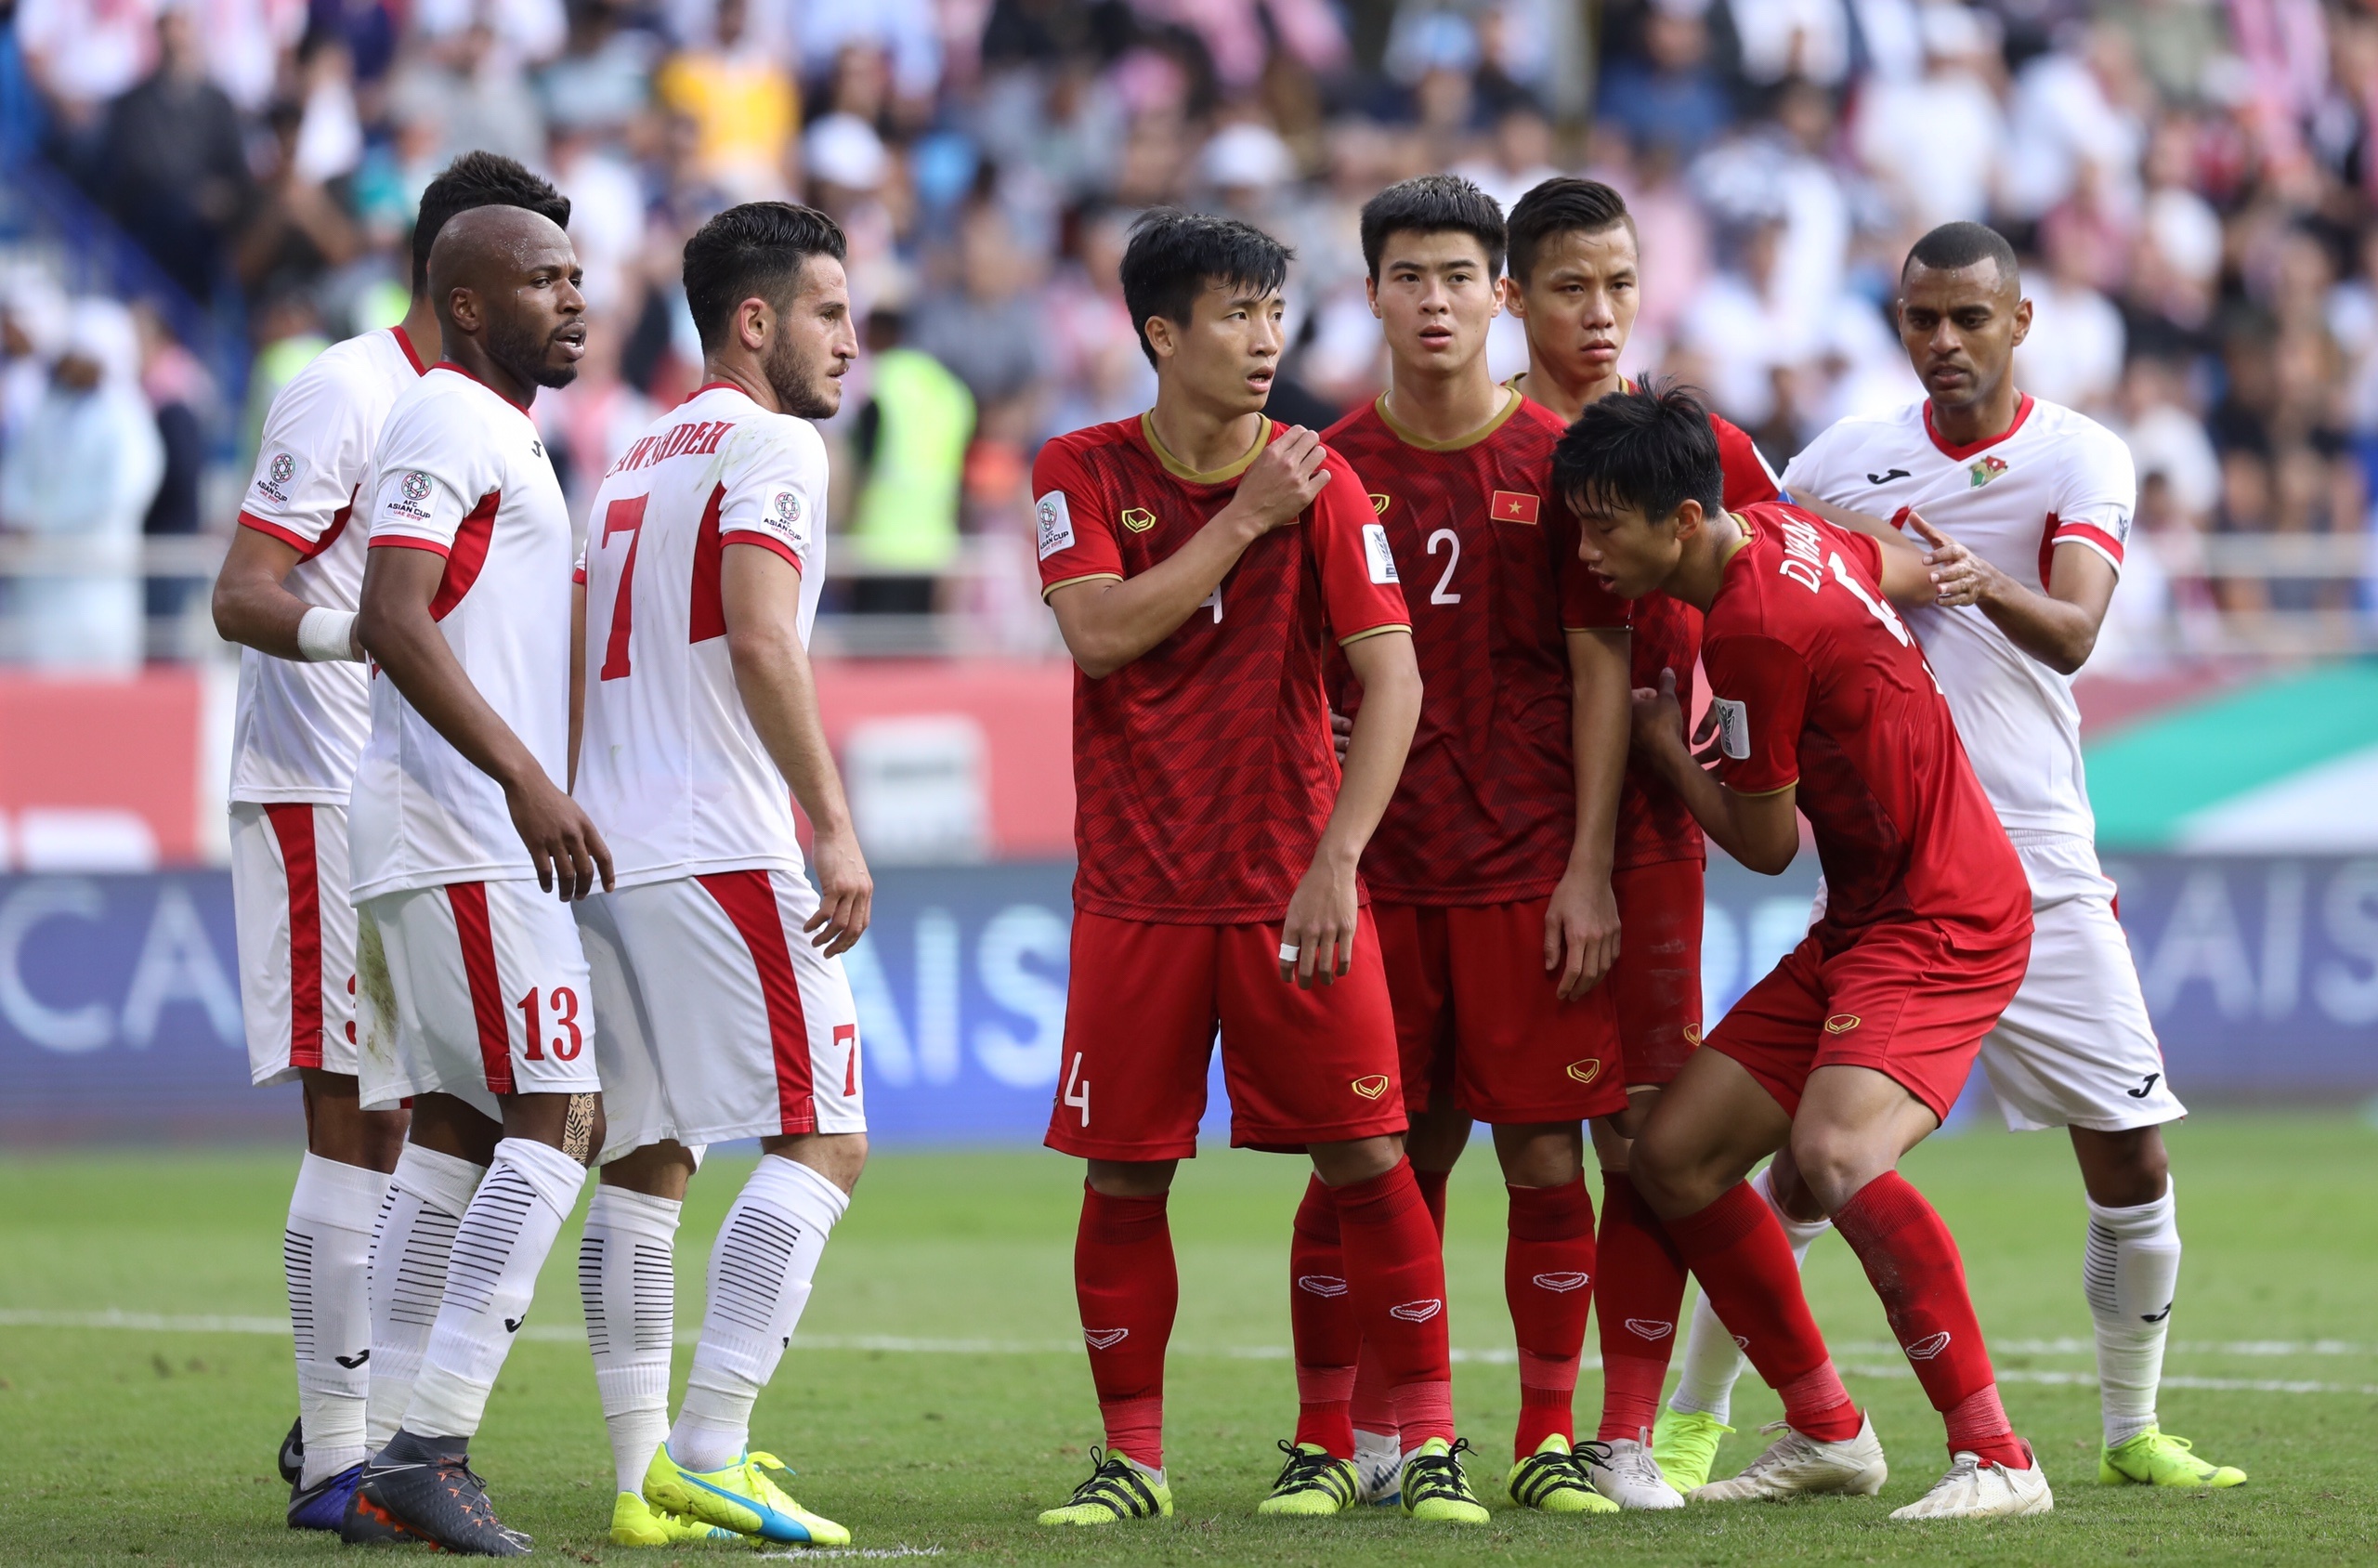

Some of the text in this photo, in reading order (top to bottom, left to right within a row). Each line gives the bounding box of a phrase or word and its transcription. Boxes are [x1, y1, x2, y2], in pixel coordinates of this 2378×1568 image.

[256, 480, 288, 502] ASIAN CUP
[386, 503, 431, 518] ASIAN CUP
[779, 518, 791, 527] AFC
[764, 518, 802, 540] ASIAN CUP
[1053, 530, 1069, 542] CUP
[601, 491, 649, 682] 7
[1427, 528, 1461, 605] 2
[2101, 858, 2378, 1026] AIS
[516, 987, 582, 1062] 13
[833, 1024, 856, 1097] 7
[1065, 1052, 1090, 1128] 4
